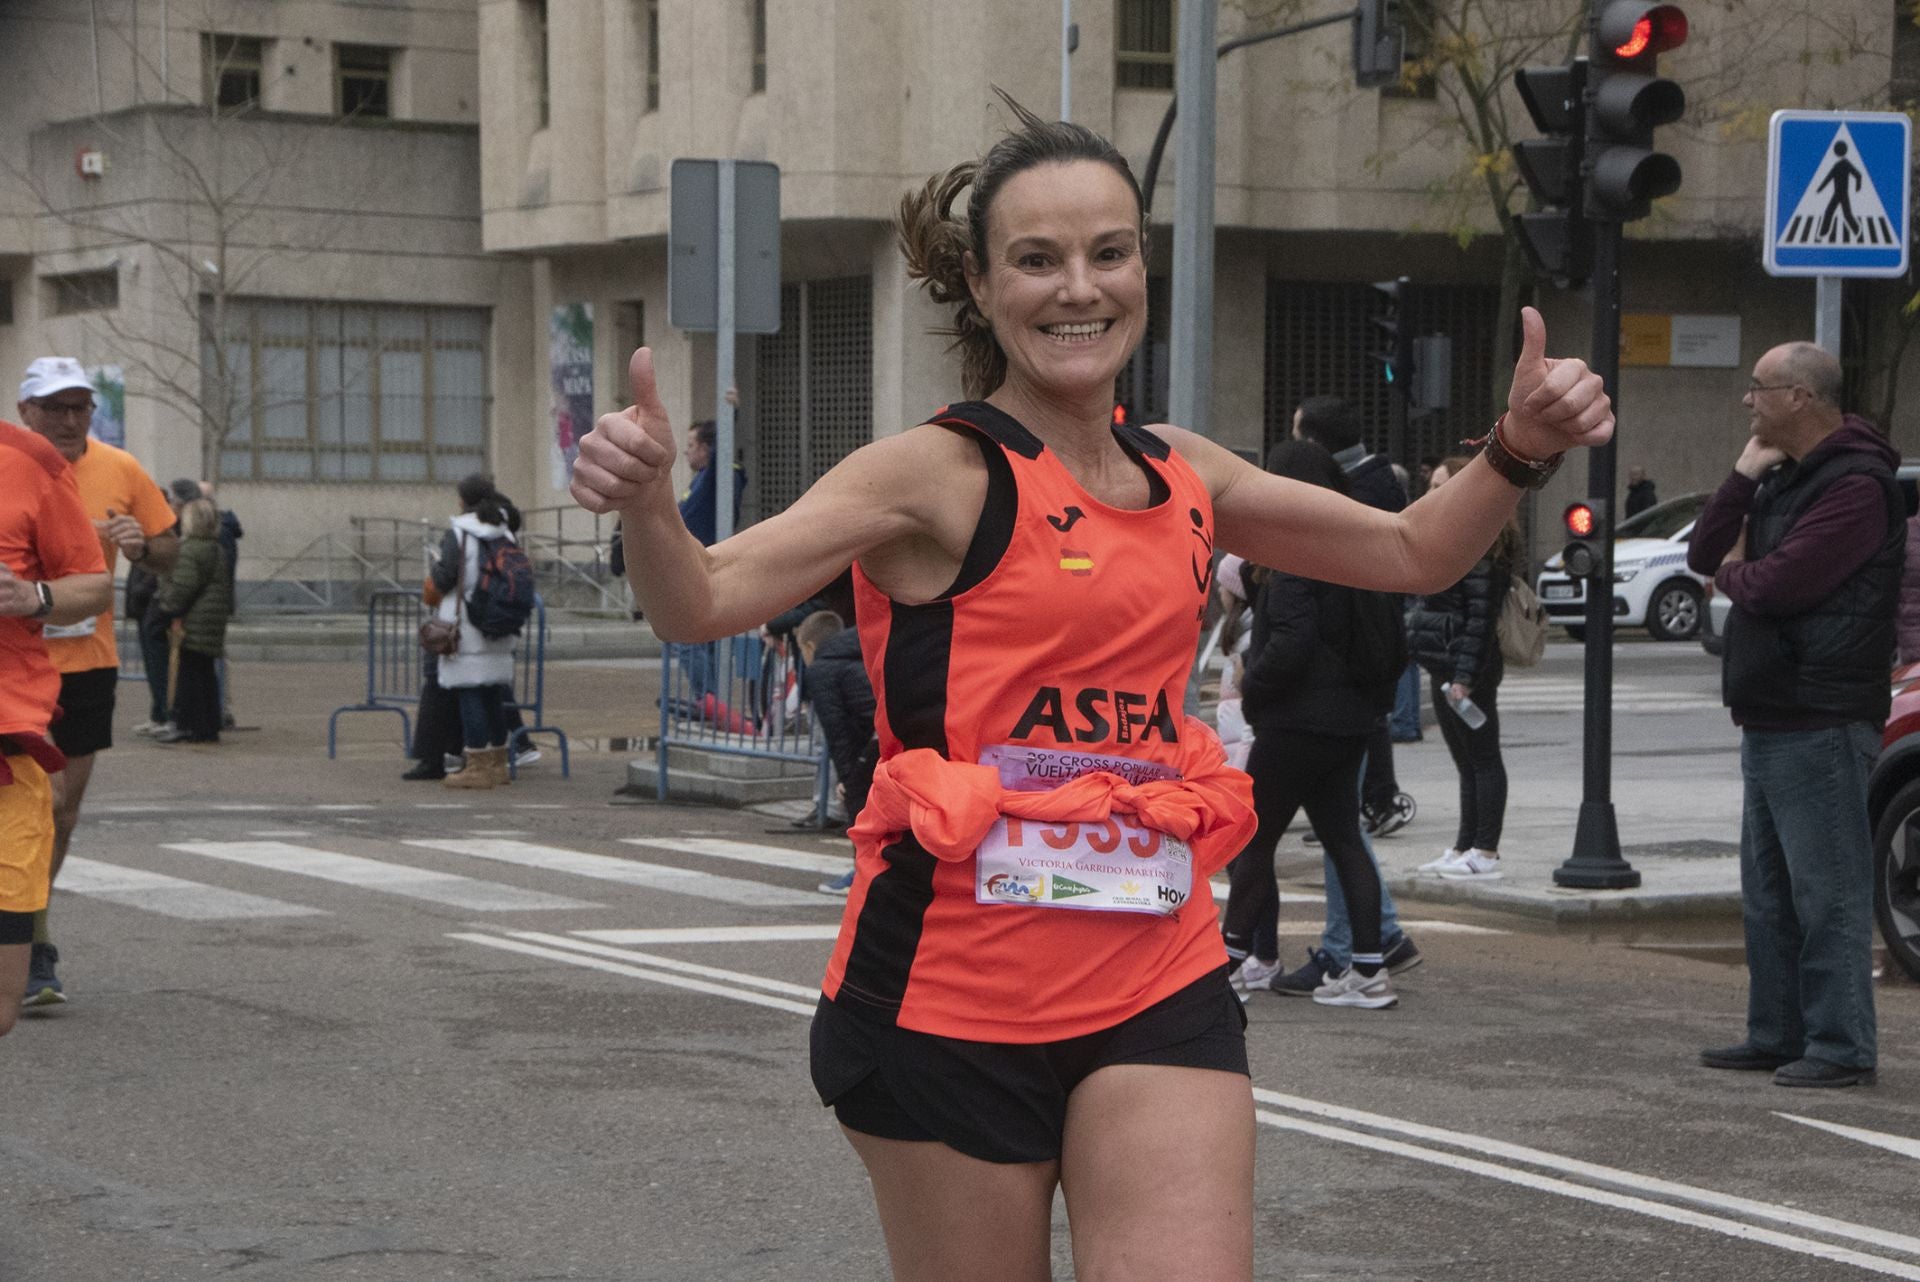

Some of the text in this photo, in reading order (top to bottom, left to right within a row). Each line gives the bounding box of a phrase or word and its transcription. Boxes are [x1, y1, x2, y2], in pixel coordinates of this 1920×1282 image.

[1008, 686, 1178, 744] ASFA
[1119, 698, 1129, 739] Badajoz
[1026, 763, 1081, 779] VUELTA
[1060, 754, 1109, 769] CROSS
[1113, 761, 1161, 777] POPULAR
[1018, 857, 1073, 870] VICTORIA
[1075, 862, 1122, 875] GARRIDO
[1157, 885, 1186, 905] HOY
